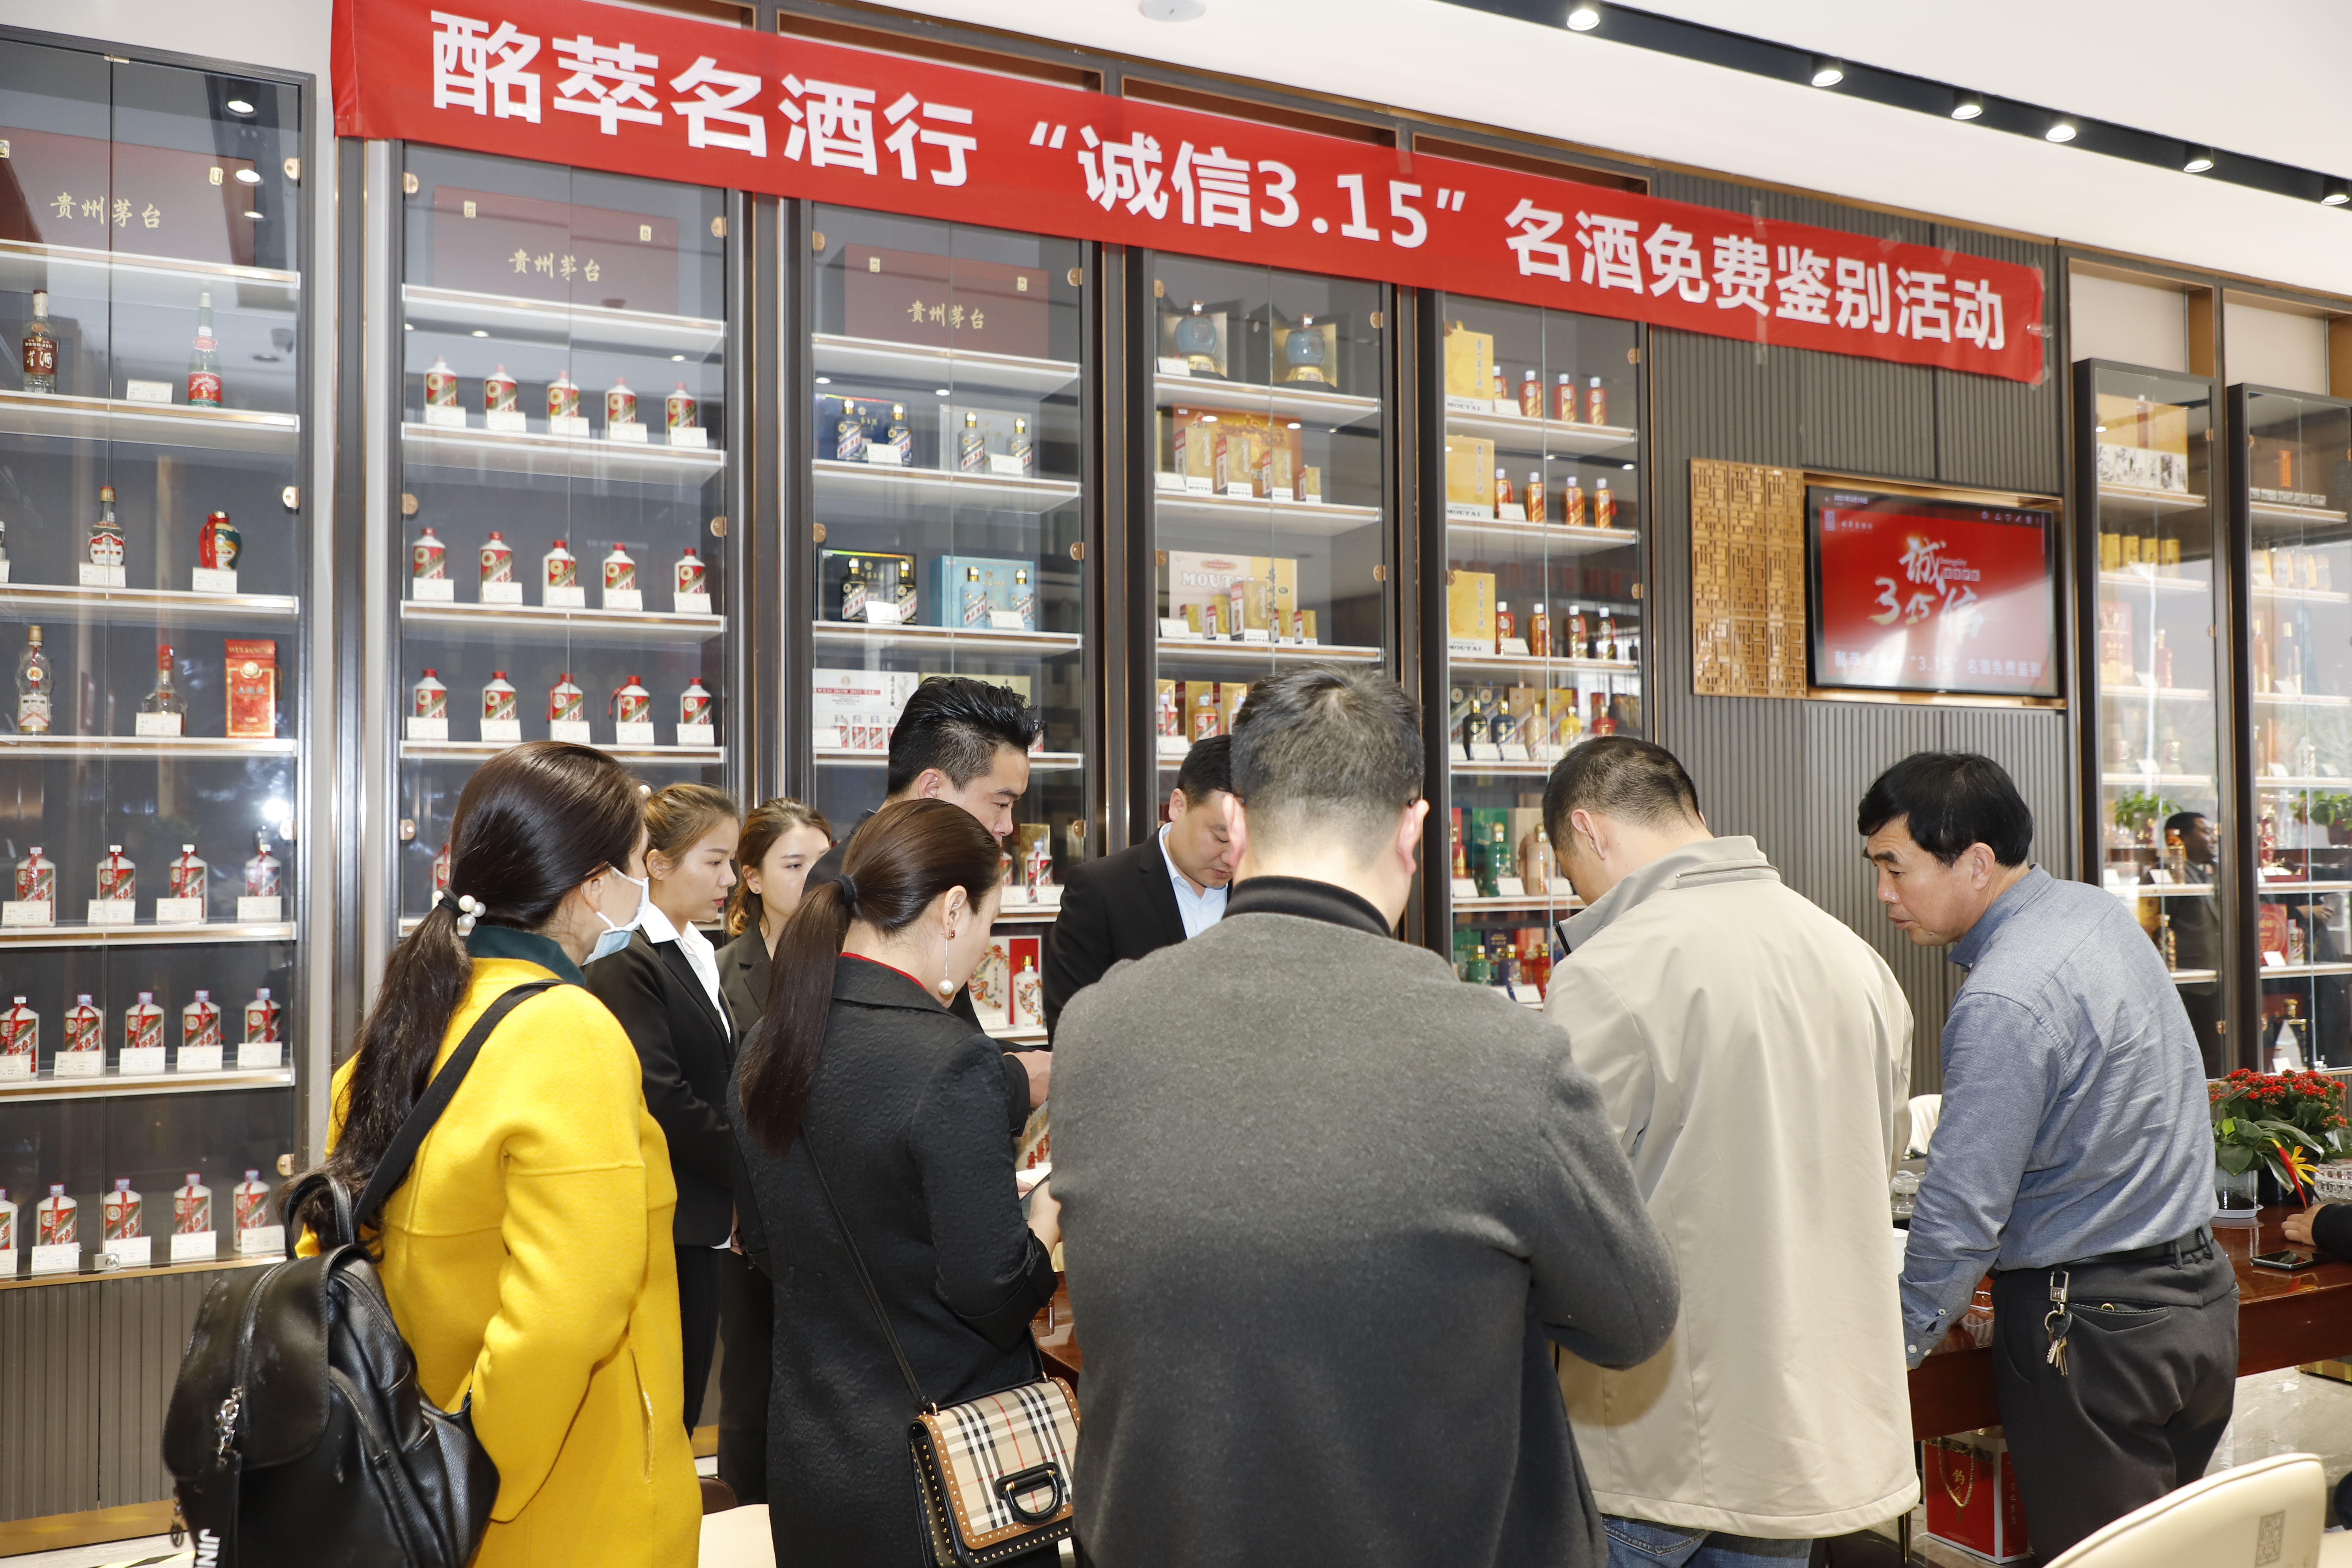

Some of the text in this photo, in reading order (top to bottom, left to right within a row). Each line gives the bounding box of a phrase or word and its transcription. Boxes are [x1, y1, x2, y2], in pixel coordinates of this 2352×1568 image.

[431, 11, 977, 186] 酩萃名酒行
[1505, 199, 2004, 349] 名酒免费鉴别活动
[50, 191, 161, 228] 贵州茅台
[508, 248, 600, 282] 贵州茅台
[907, 300, 985, 329] 贵州茅台
[1447, 402, 1481, 411] MOUTAI
[1182, 573, 1255, 588] MOUT
[194, 1528, 221, 1568] JIN
